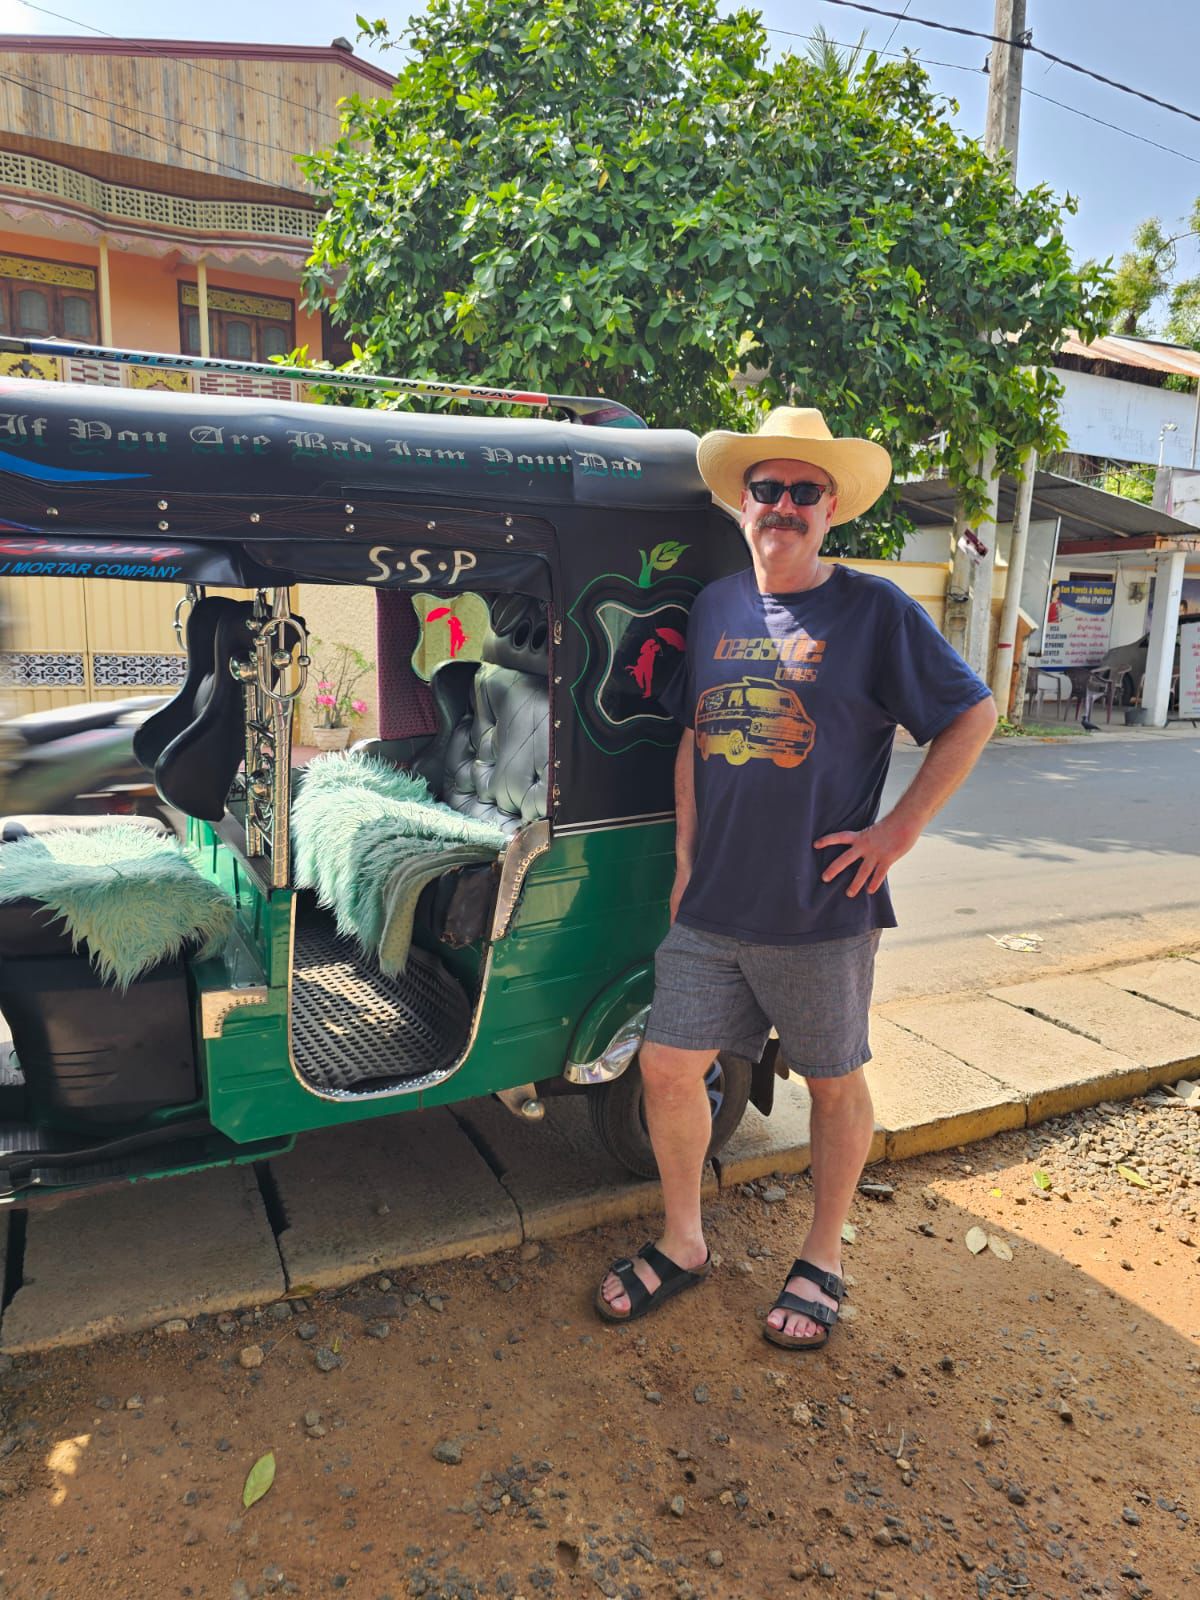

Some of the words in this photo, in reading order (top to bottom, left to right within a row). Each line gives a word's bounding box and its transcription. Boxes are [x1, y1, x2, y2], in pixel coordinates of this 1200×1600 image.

[74, 348, 194, 367] BETTER
[301, 371, 378, 385] COME
[392, 379, 419, 389] IN
[427, 383, 461, 394] MY
[470, 388, 521, 399] WAY
[0, 413, 48, 448] If
[68, 418, 169, 456] You
[189, 425, 273, 456] Are
[285, 429, 373, 463] Bad
[480, 446, 573, 475] Your
[574, 449, 641, 480] Dad
[0, 537, 185, 562] Racing
[11, 562, 89, 575] MORTAR
[94, 563, 183, 578] COMPANY
